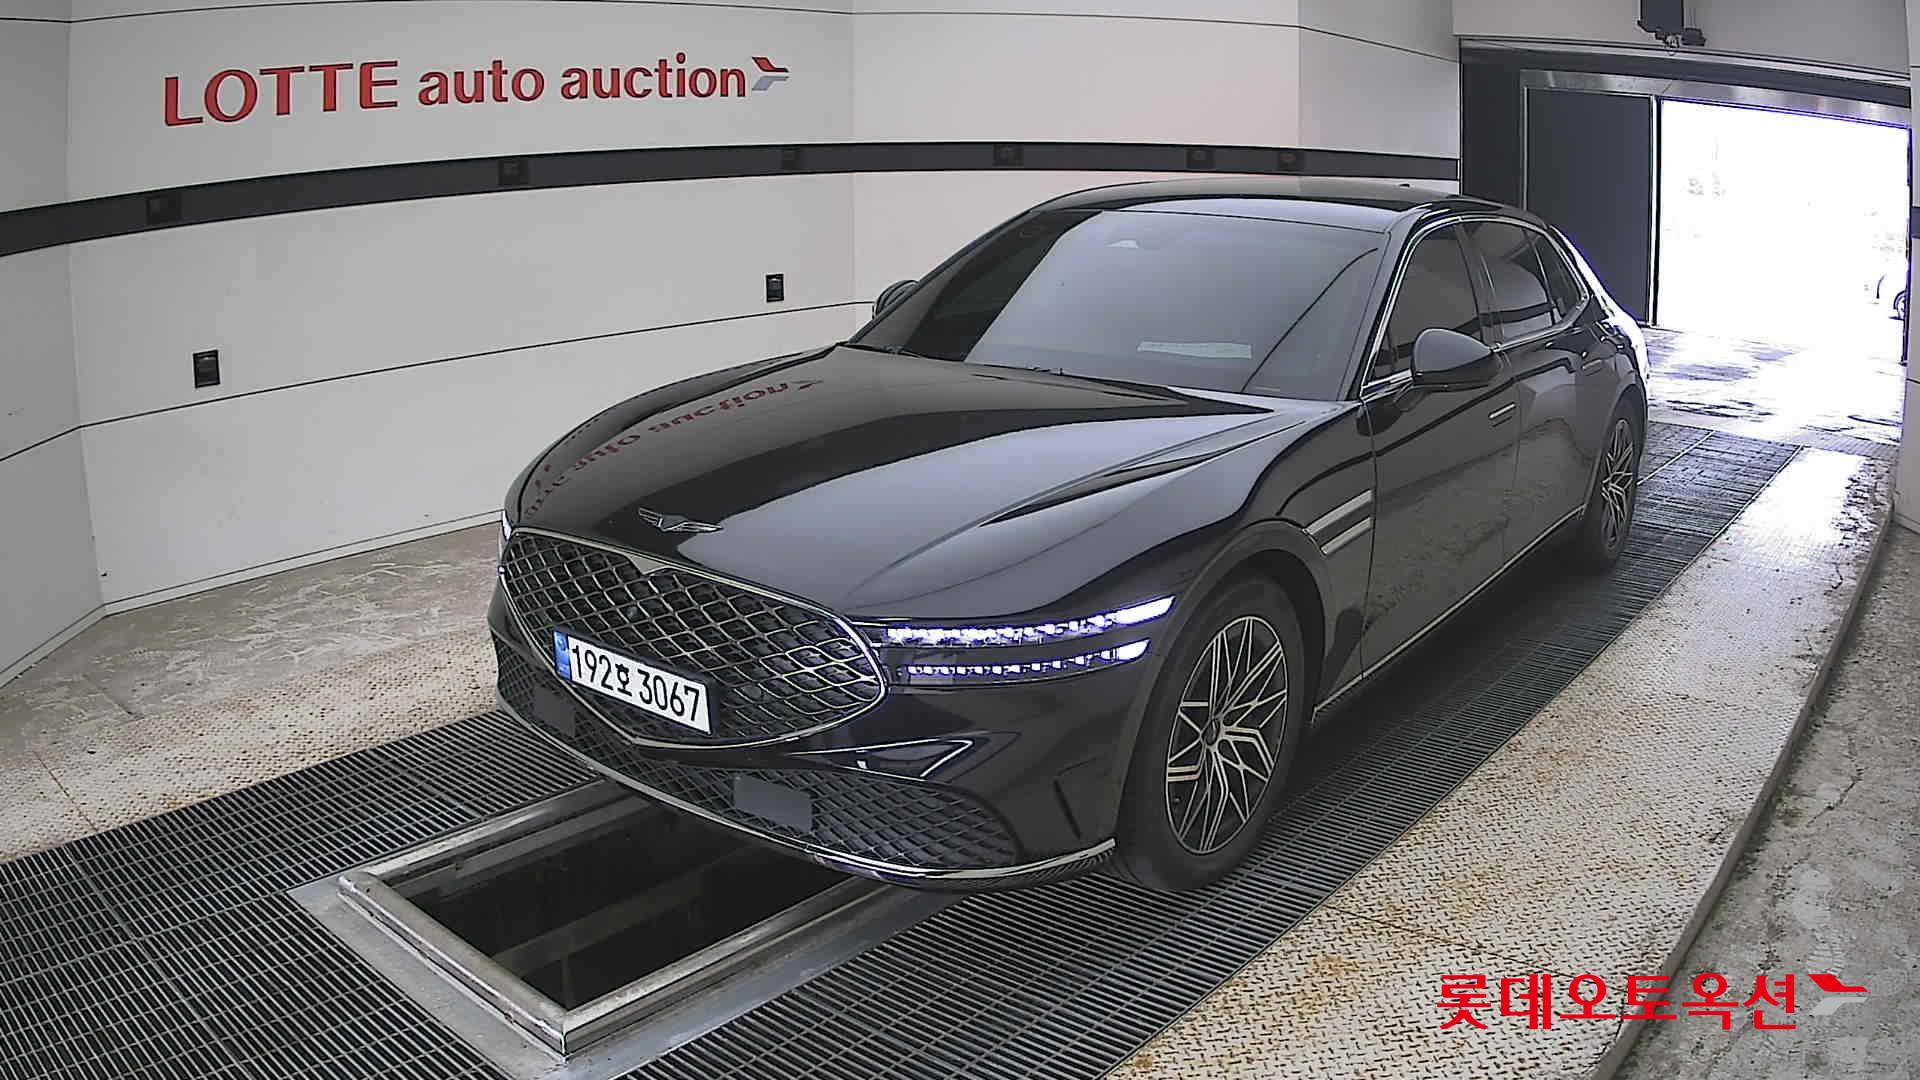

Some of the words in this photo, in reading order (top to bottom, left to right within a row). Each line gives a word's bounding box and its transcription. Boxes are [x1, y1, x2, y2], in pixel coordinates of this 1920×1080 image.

[164, 60, 398, 126] LOTTE
[417, 59, 545, 105] auto
[560, 52, 746, 99] auction
[573, 645, 632, 696] 192호
[638, 669, 700, 721] 3067
